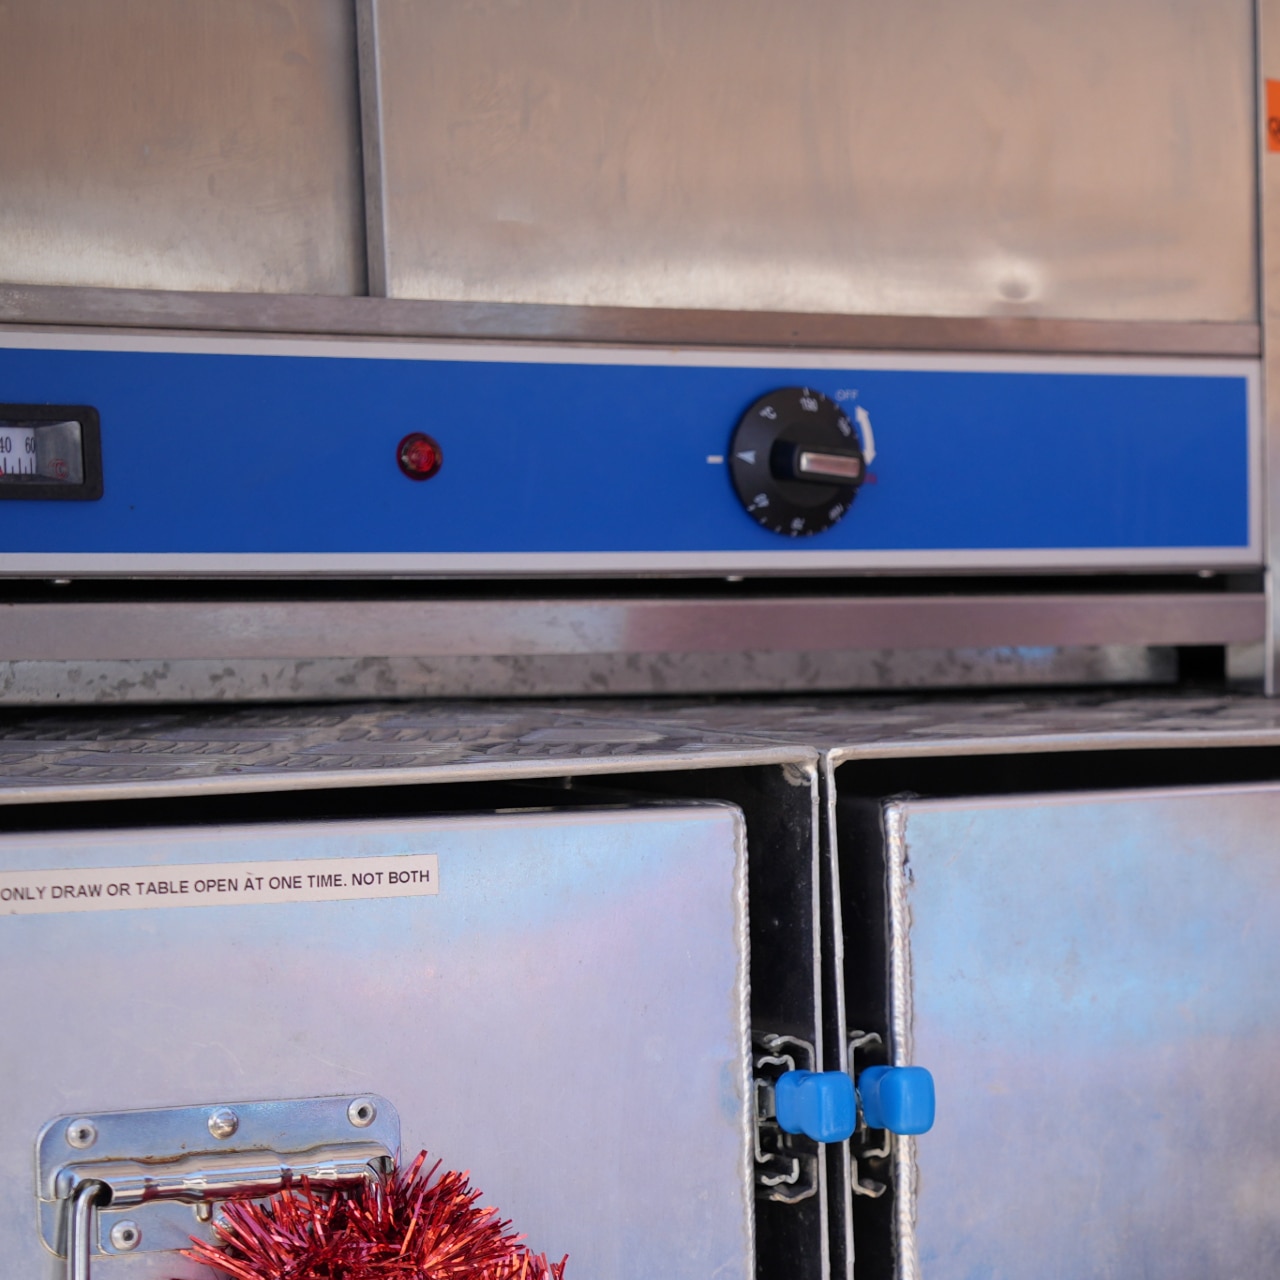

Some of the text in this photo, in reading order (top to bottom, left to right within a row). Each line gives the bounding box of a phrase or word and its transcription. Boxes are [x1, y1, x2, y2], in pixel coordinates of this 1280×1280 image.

[1, 870, 430, 901] ONLY DRAW OR TABLE OPEN AT ONE TIME. NOT BOTH
